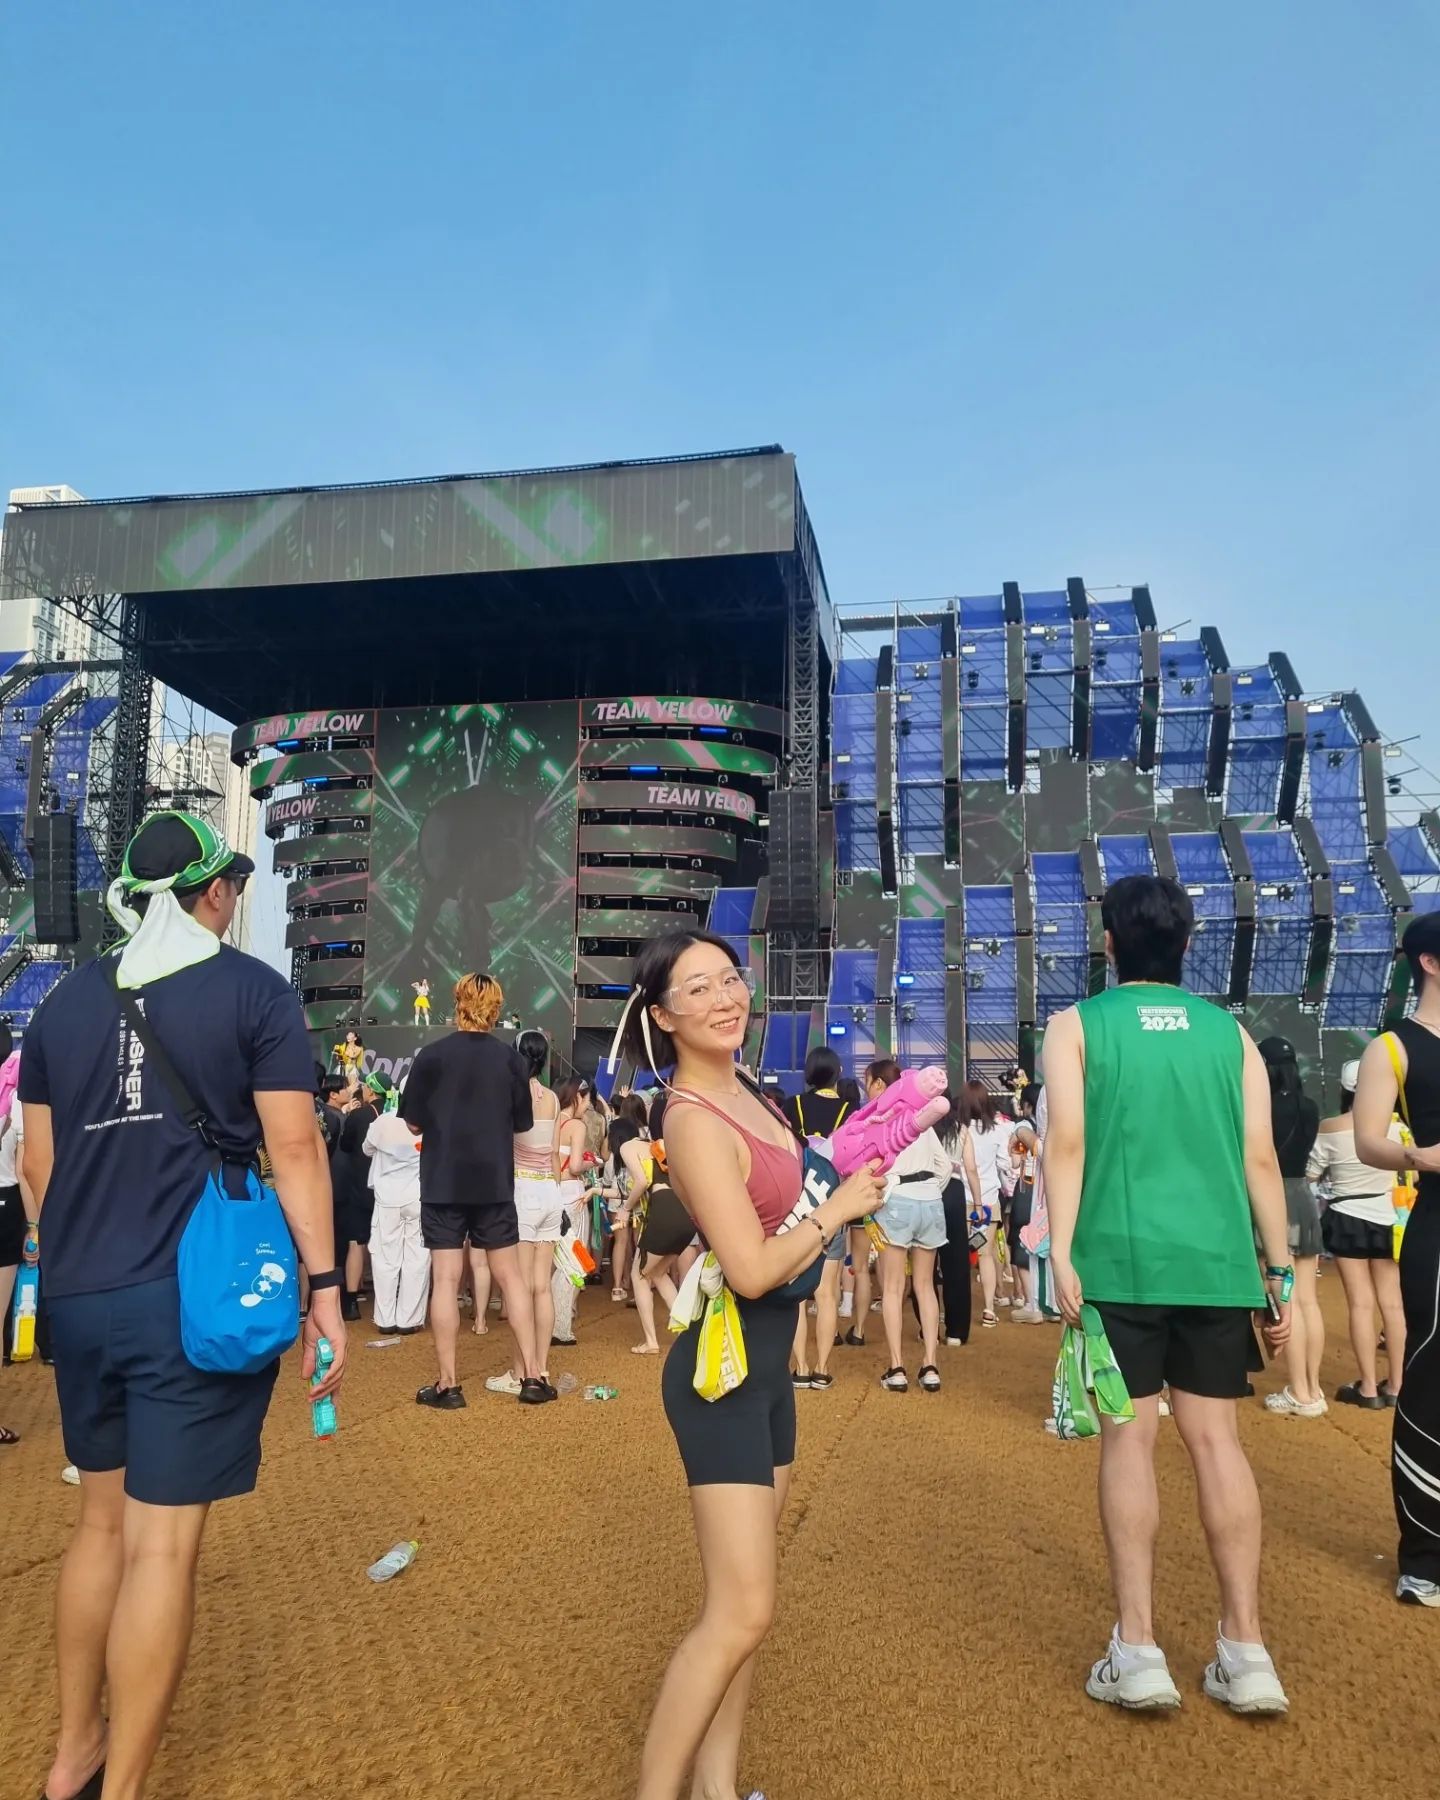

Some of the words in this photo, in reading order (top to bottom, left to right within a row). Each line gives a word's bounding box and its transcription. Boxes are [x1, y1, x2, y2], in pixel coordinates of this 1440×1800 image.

[597, 702, 650, 721] TEAM
[656, 701, 735, 721] YELLOW
[253, 720, 290, 737] TEAM
[292, 714, 365, 738] YELLOW
[647, 786, 701, 807] TEAM
[270, 797, 319, 822] YELLOW
[1140, 1016, 1191, 1032] 2024
